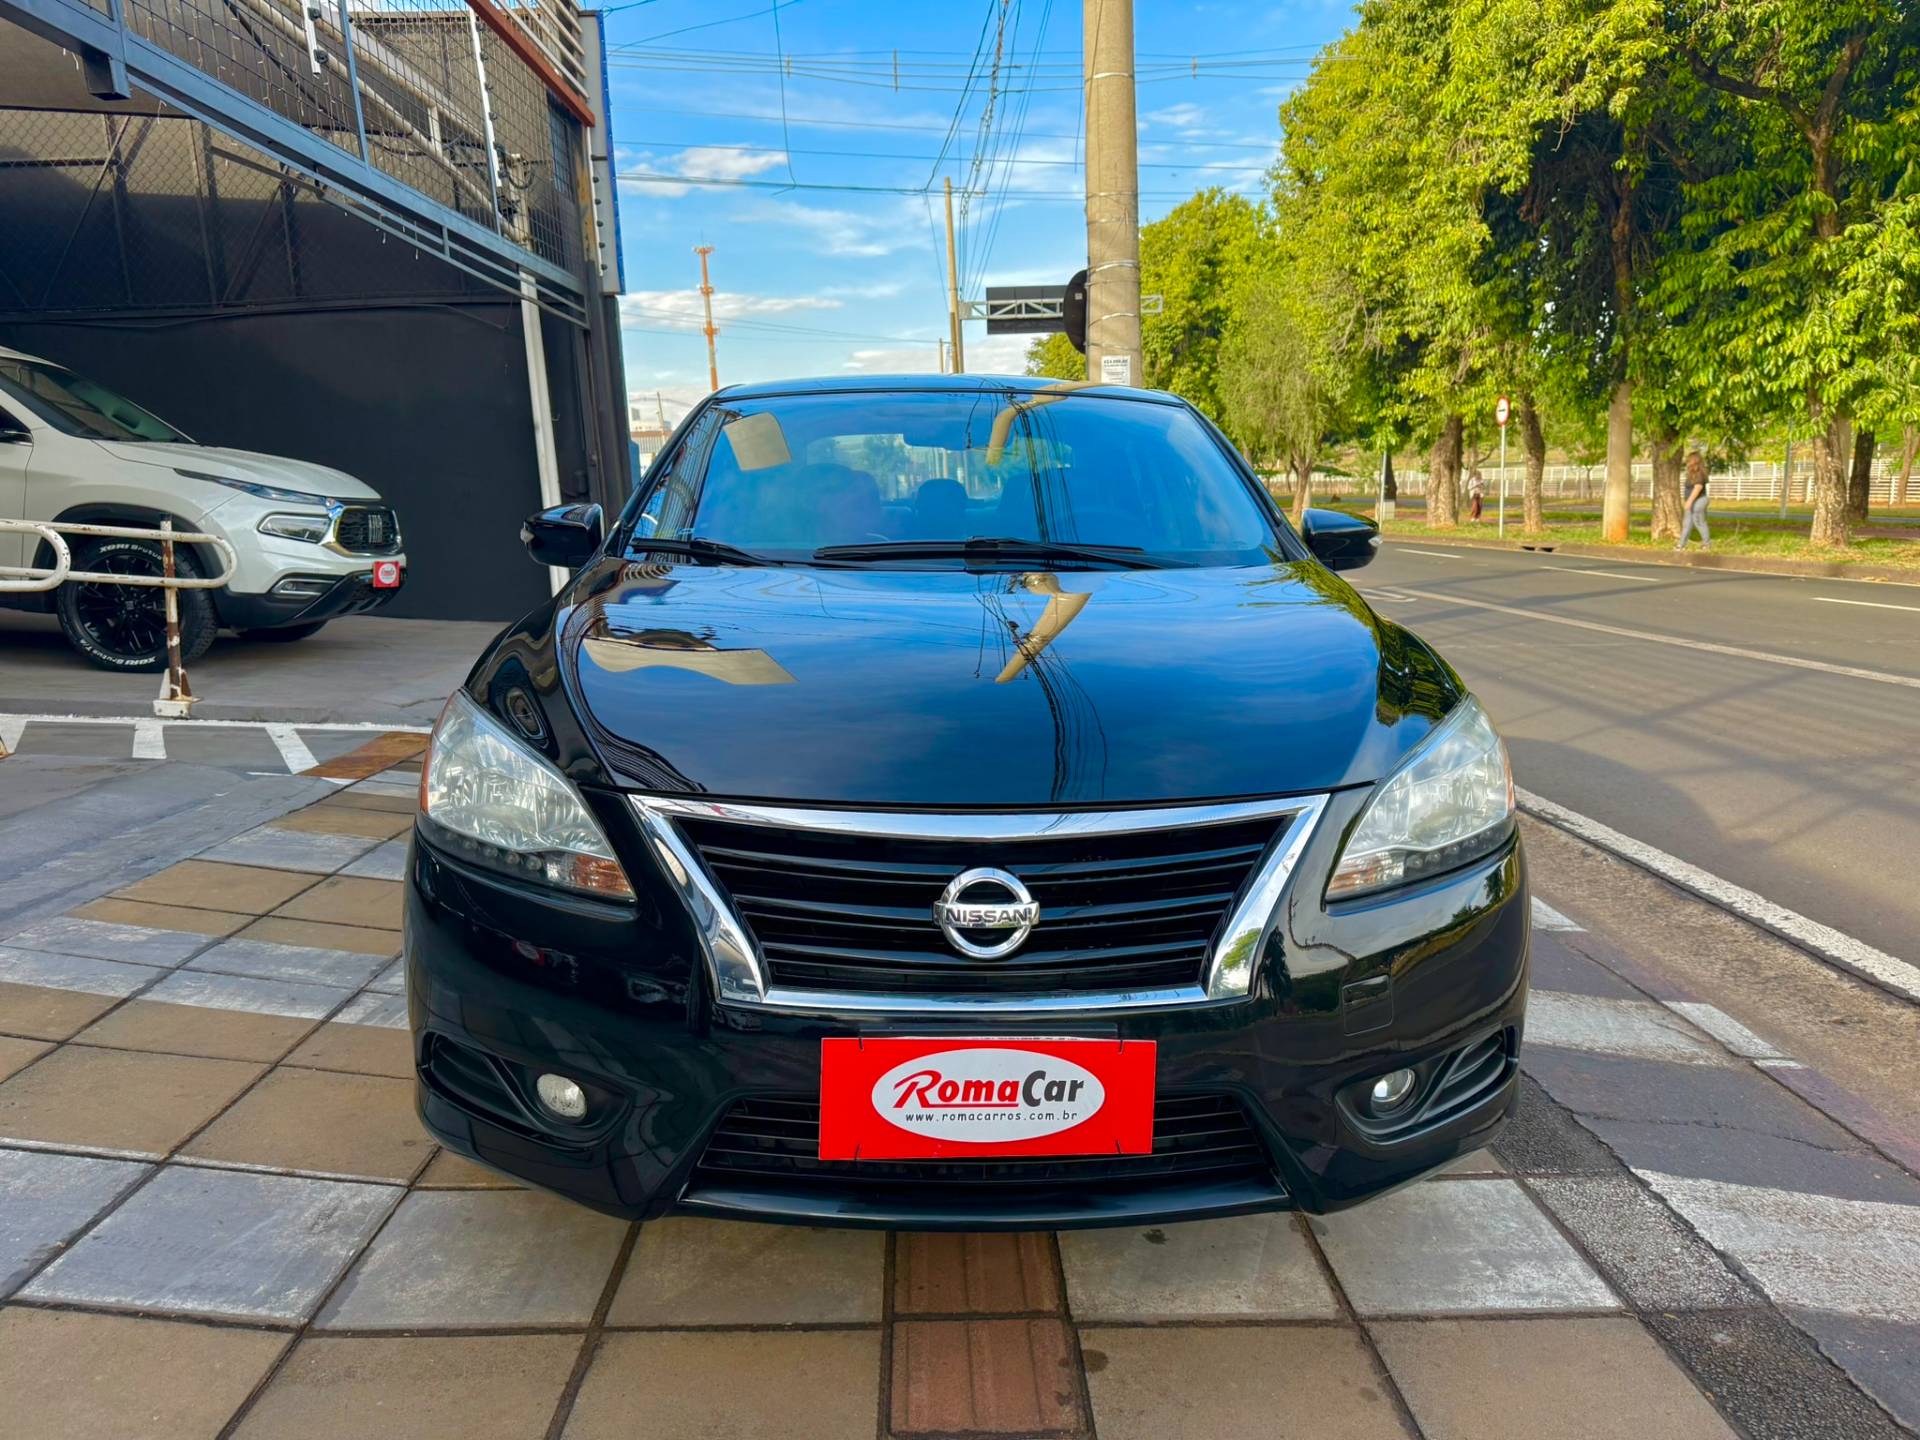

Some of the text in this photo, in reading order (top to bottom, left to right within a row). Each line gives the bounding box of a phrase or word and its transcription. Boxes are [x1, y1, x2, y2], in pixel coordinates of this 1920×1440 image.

[945, 907, 1029, 922] NISSAN
[893, 1069, 1084, 1108] RomaCar
[904, 1110, 1078, 1122] www.romacarros.com.br
